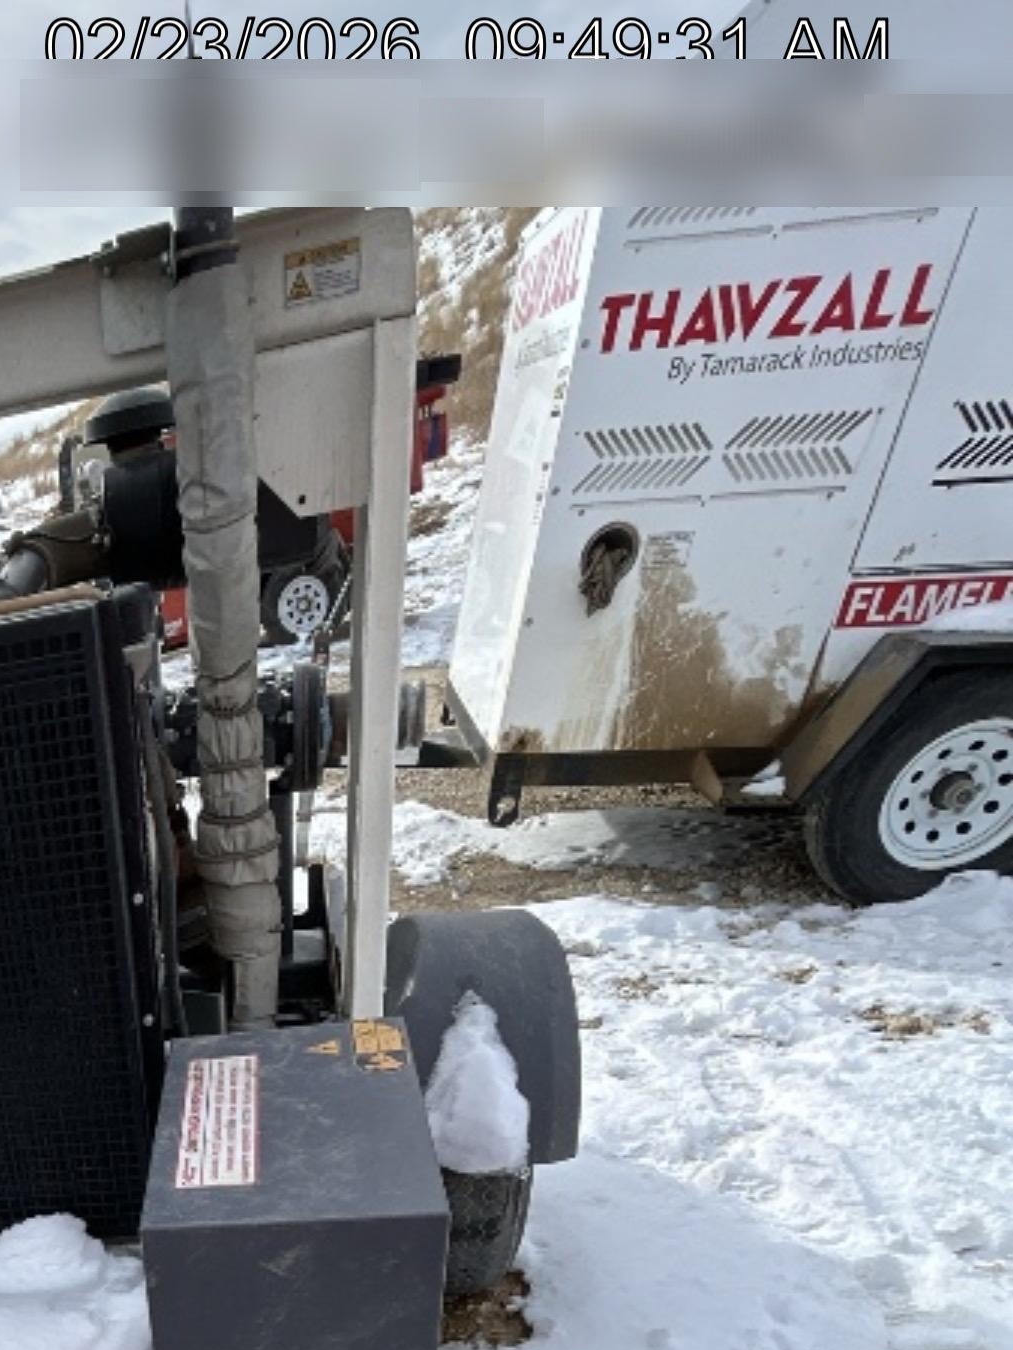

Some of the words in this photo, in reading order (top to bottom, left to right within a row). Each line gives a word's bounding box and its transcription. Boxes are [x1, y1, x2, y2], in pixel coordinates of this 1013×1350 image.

[599, 263, 934, 355] THAWZALL
[667, 356, 697, 385] By
[699, 345, 805, 379] Tamarack
[808, 335, 927, 369] Industries
